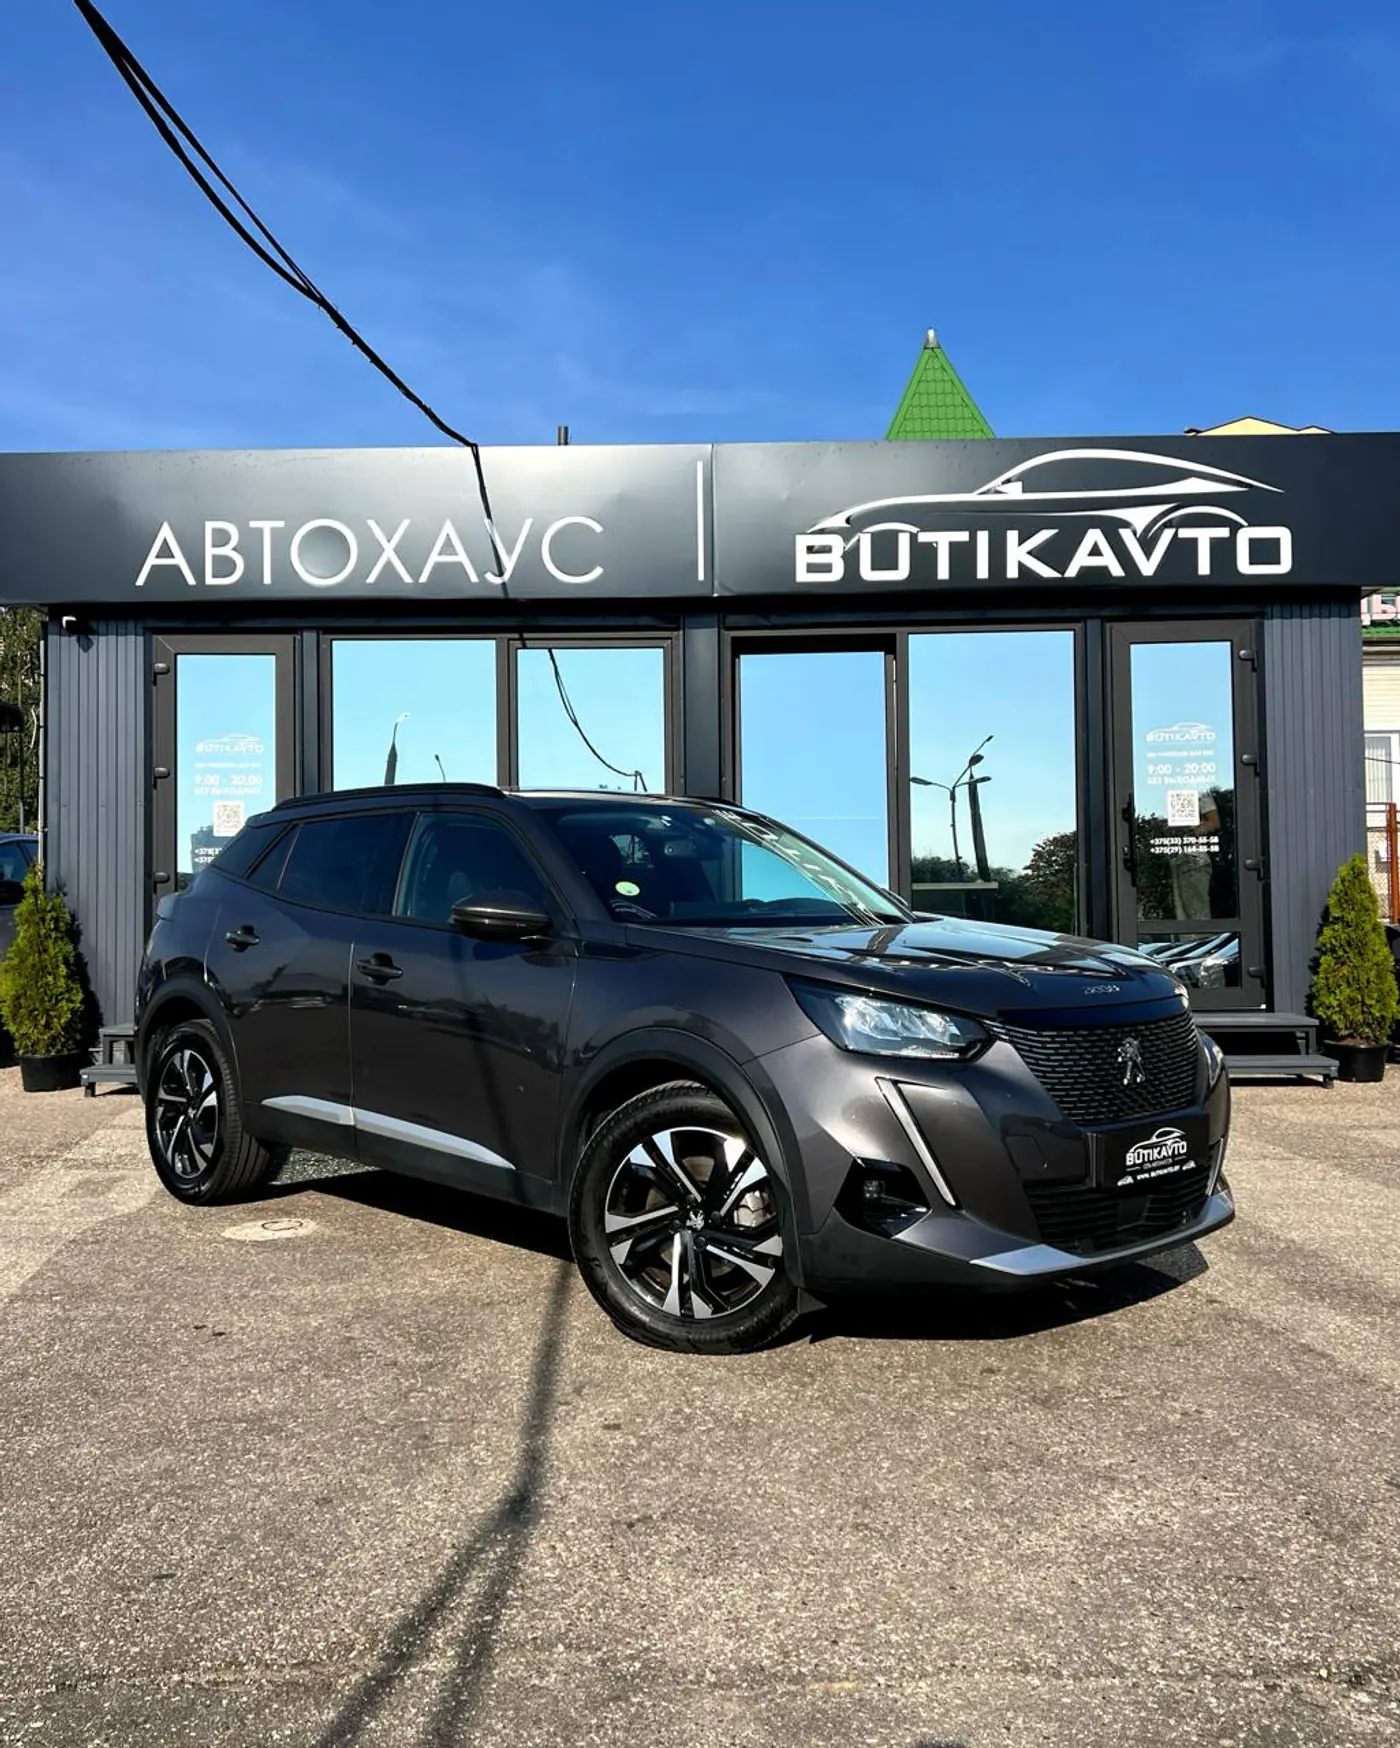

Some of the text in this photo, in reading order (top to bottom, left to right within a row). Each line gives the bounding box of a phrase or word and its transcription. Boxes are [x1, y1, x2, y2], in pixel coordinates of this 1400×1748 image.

[135, 516, 604, 587] АВТОХАУС
[794, 525, 1293, 583] BUTIKAVTO
[1183, 762, 1217, 774] 20:00
[1125, 1141, 1187, 1166] BUTIKAVTO
